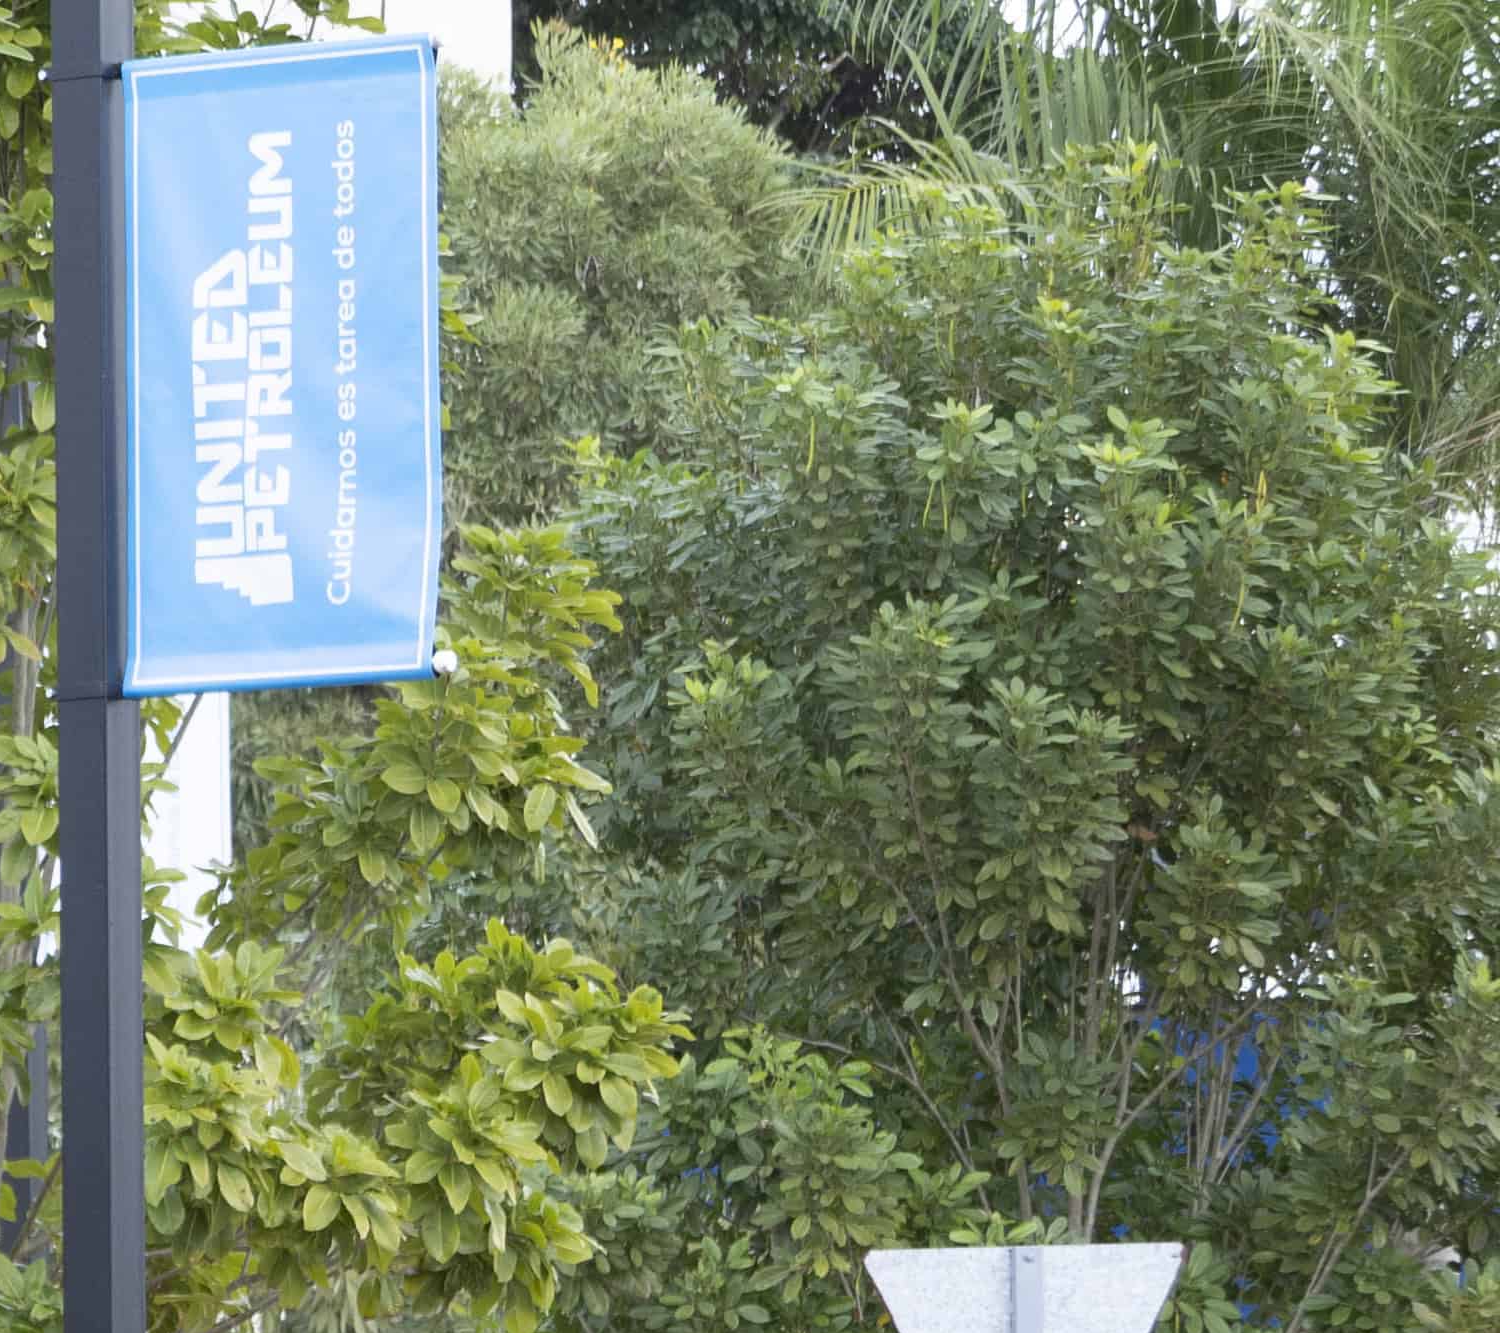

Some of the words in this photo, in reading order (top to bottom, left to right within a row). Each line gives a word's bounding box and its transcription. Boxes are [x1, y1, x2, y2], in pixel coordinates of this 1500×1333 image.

[331, 119, 355, 217] todos
[331, 224, 355, 270] de
[244, 130, 293, 552] PETROLEUM
[333, 279, 357, 377] tarea
[191, 248, 248, 557] UNITED
[338, 383, 356, 420] es
[326, 430, 357, 605] Cuidarnos
